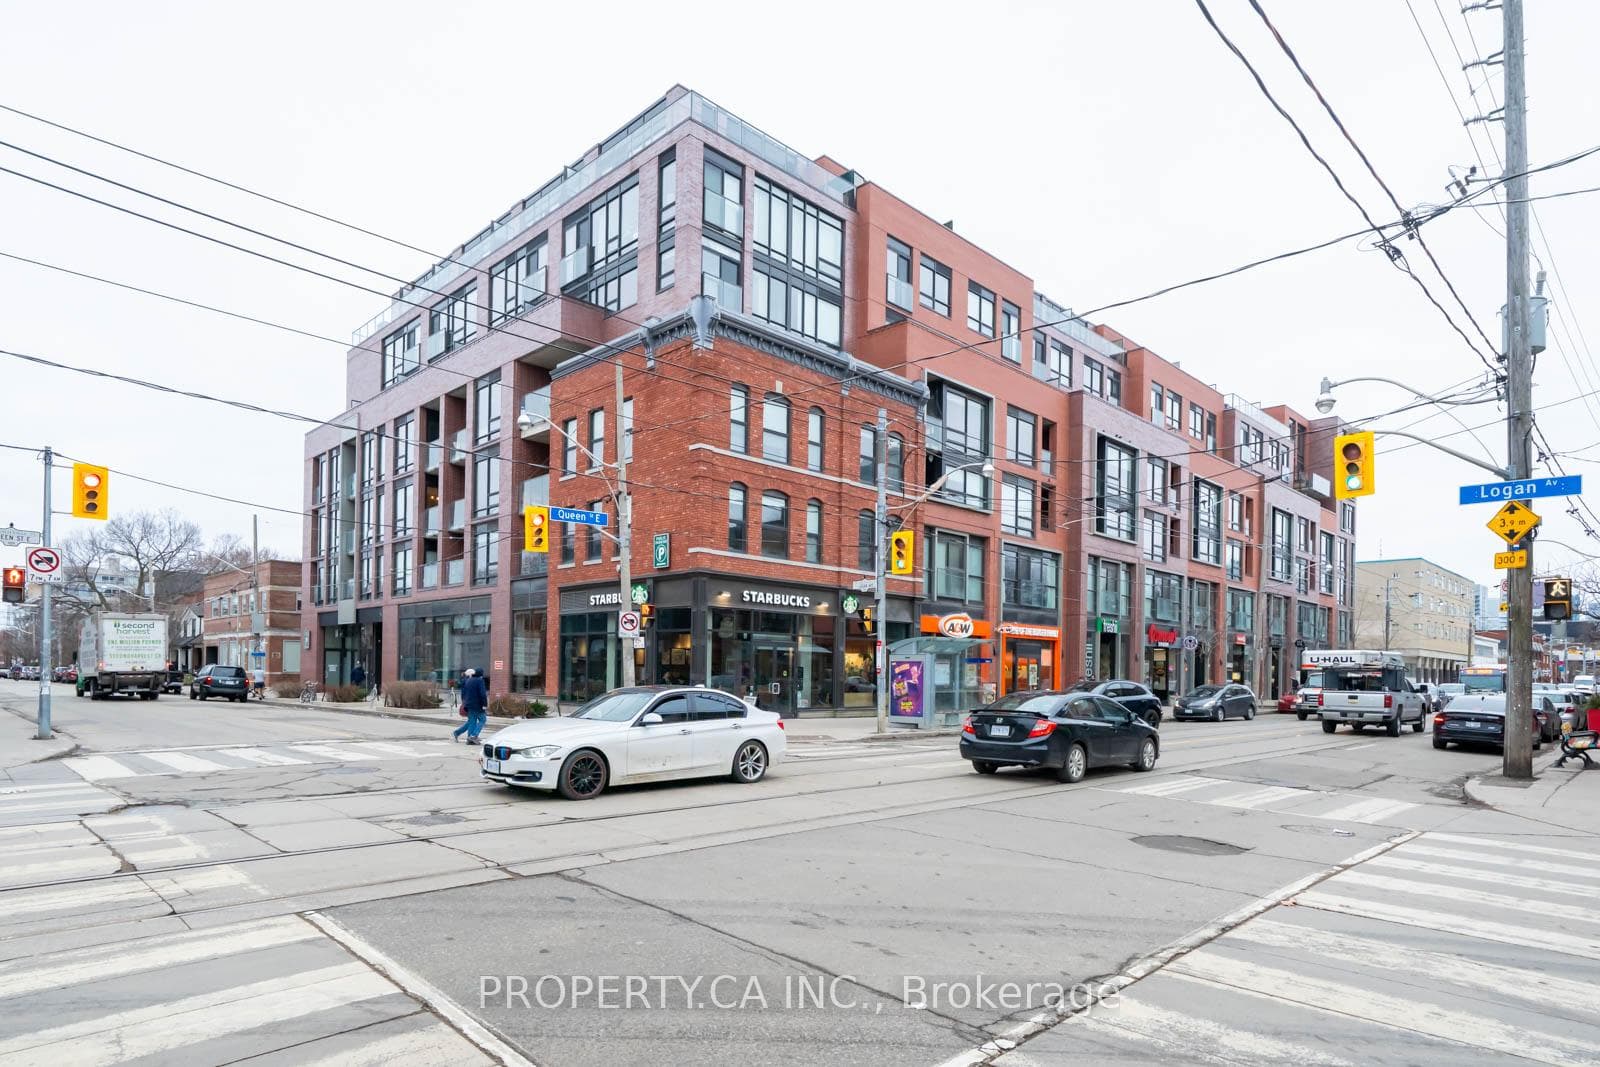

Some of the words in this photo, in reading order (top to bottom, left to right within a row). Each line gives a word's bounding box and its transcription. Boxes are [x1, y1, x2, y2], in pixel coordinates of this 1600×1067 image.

[1480, 483, 1537, 499] Logan
[558, 509, 586, 521] Queen
[596, 514, 601, 523] E
[1500, 519, 1514, 528] 3.9
[1497, 555, 1516, 565] 300
[590, 593, 623, 606] STARBU
[742, 590, 810, 608] STARBUCKS
[947, 622, 971, 634] A&W
